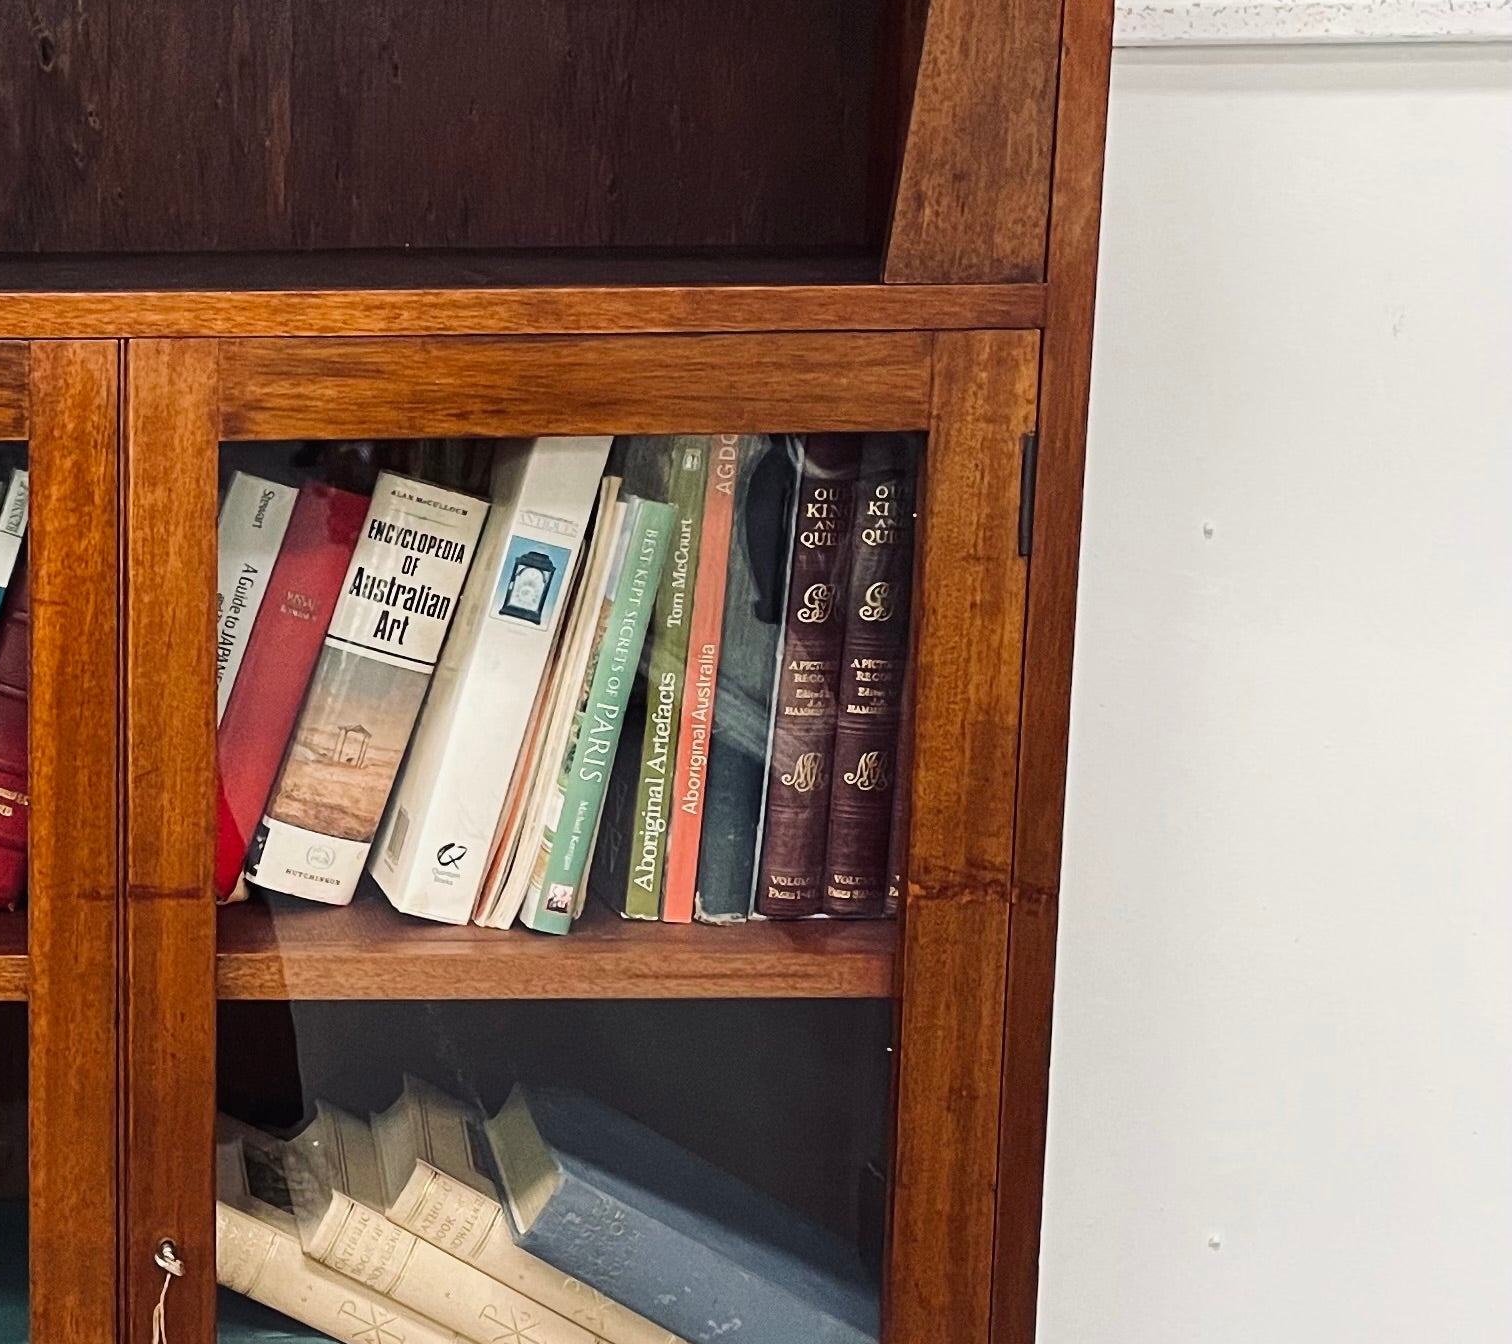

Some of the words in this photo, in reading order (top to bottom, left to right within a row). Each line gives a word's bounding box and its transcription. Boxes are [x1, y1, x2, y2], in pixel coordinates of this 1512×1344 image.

[252, 488, 275, 529] Stewart
[390, 489, 414, 501] ALAN
[367, 518, 466, 564] ENCYCLOPEDIA
[639, 528, 660, 564] BEST
[672, 518, 694, 590] McCourt
[241, 563, 258, 575] A
[401, 555, 421, 576] OF
[229, 575, 254, 614] Guide
[349, 566, 451, 621] Australian
[628, 568, 649, 607] KEPT
[224, 614, 240, 629] to
[373, 609, 410, 645] Art
[667, 593, 685, 629] Tom
[612, 609, 639, 673] SECRETS
[605, 677, 622, 697] OF
[691, 644, 716, 722] Australia
[647, 671, 676, 774] Artefacts
[579, 702, 620, 783] PARIS
[681, 724, 708, 815] Aboriginal
[634, 777, 666, 892] Aboriginal
[285, 867, 341, 886] HUTCHINSON
[334, 1211, 371, 1270] CATHOLIC
[433, 1215, 457, 1241] OOK
[351, 1247, 374, 1276] BOOK
